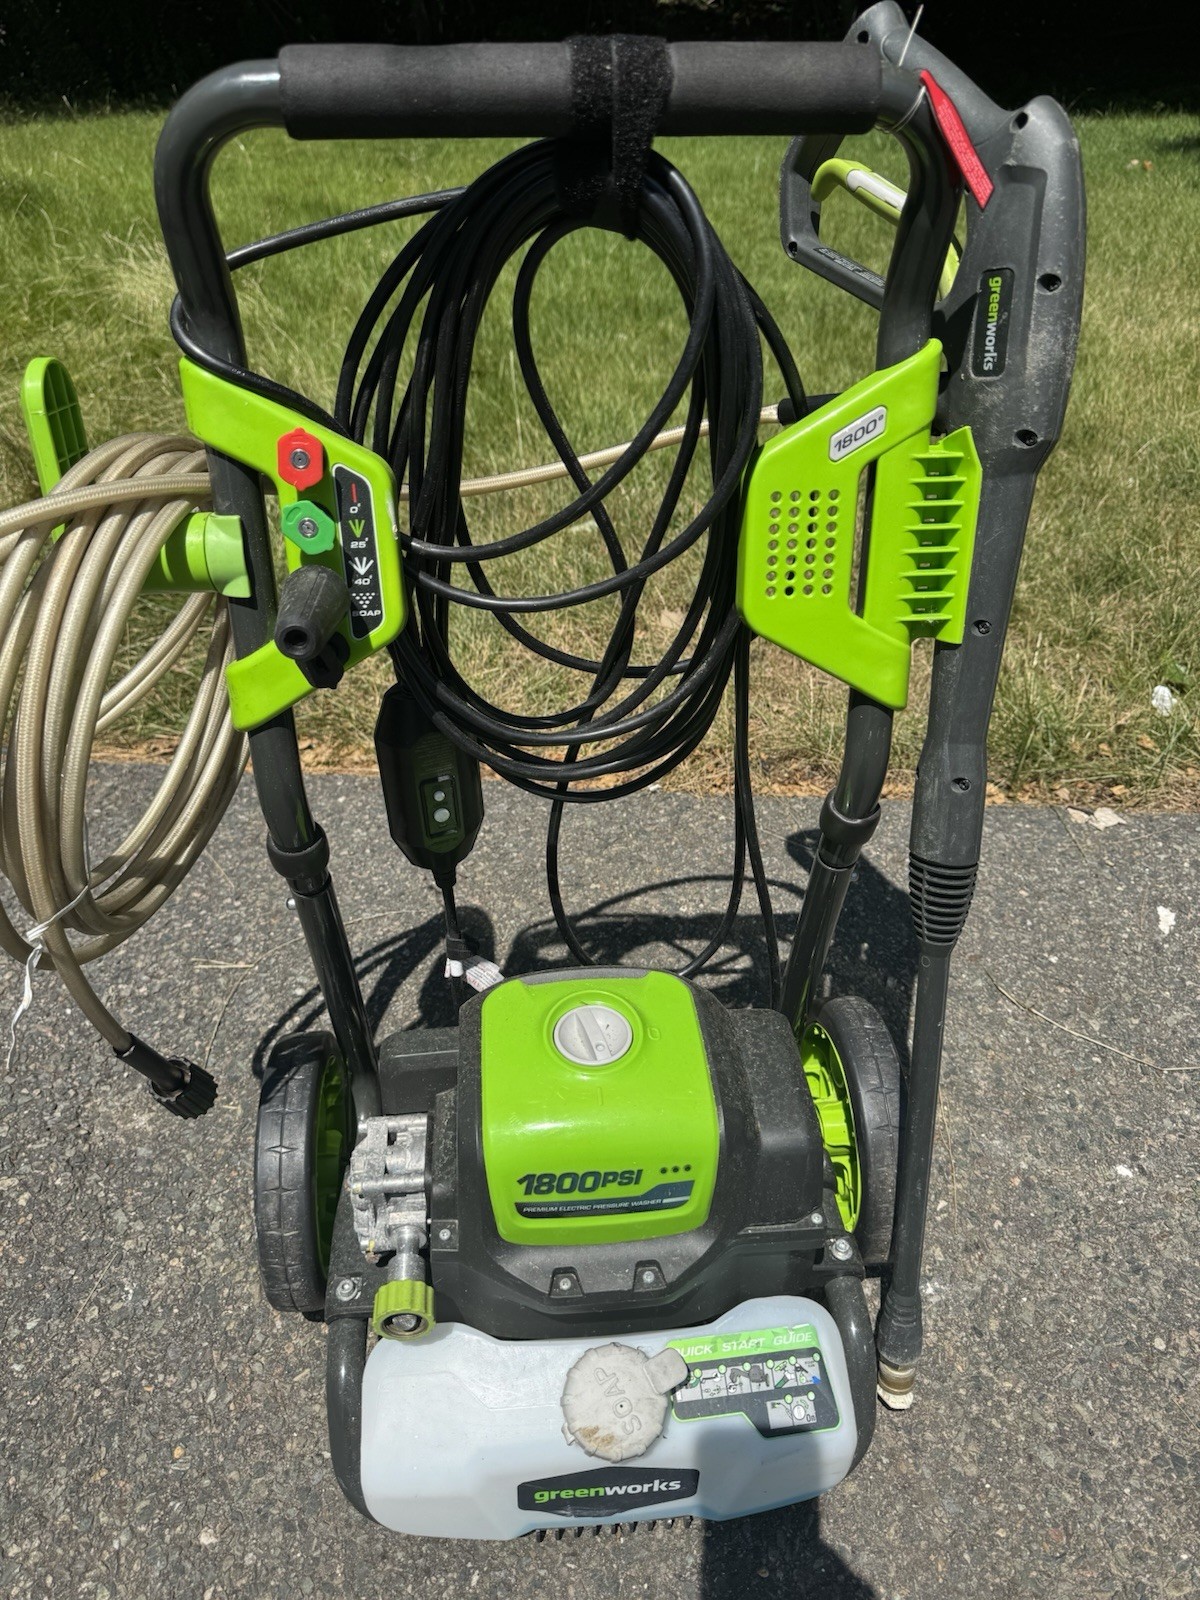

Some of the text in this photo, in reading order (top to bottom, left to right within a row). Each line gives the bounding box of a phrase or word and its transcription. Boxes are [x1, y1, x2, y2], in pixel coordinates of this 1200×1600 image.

[983, 276, 1002, 371] greenworks
[559, 1204, 592, 1212] ELECTRIC
[592, 1202, 630, 1210] PRESSURE
[631, 1199, 662, 1207] WASHER
[722, 1337, 766, 1352] START
[773, 1331, 813, 1346] GUIDE
[594, 1367, 642, 1435] SOAP
[533, 1479, 681, 1503] greenworks
